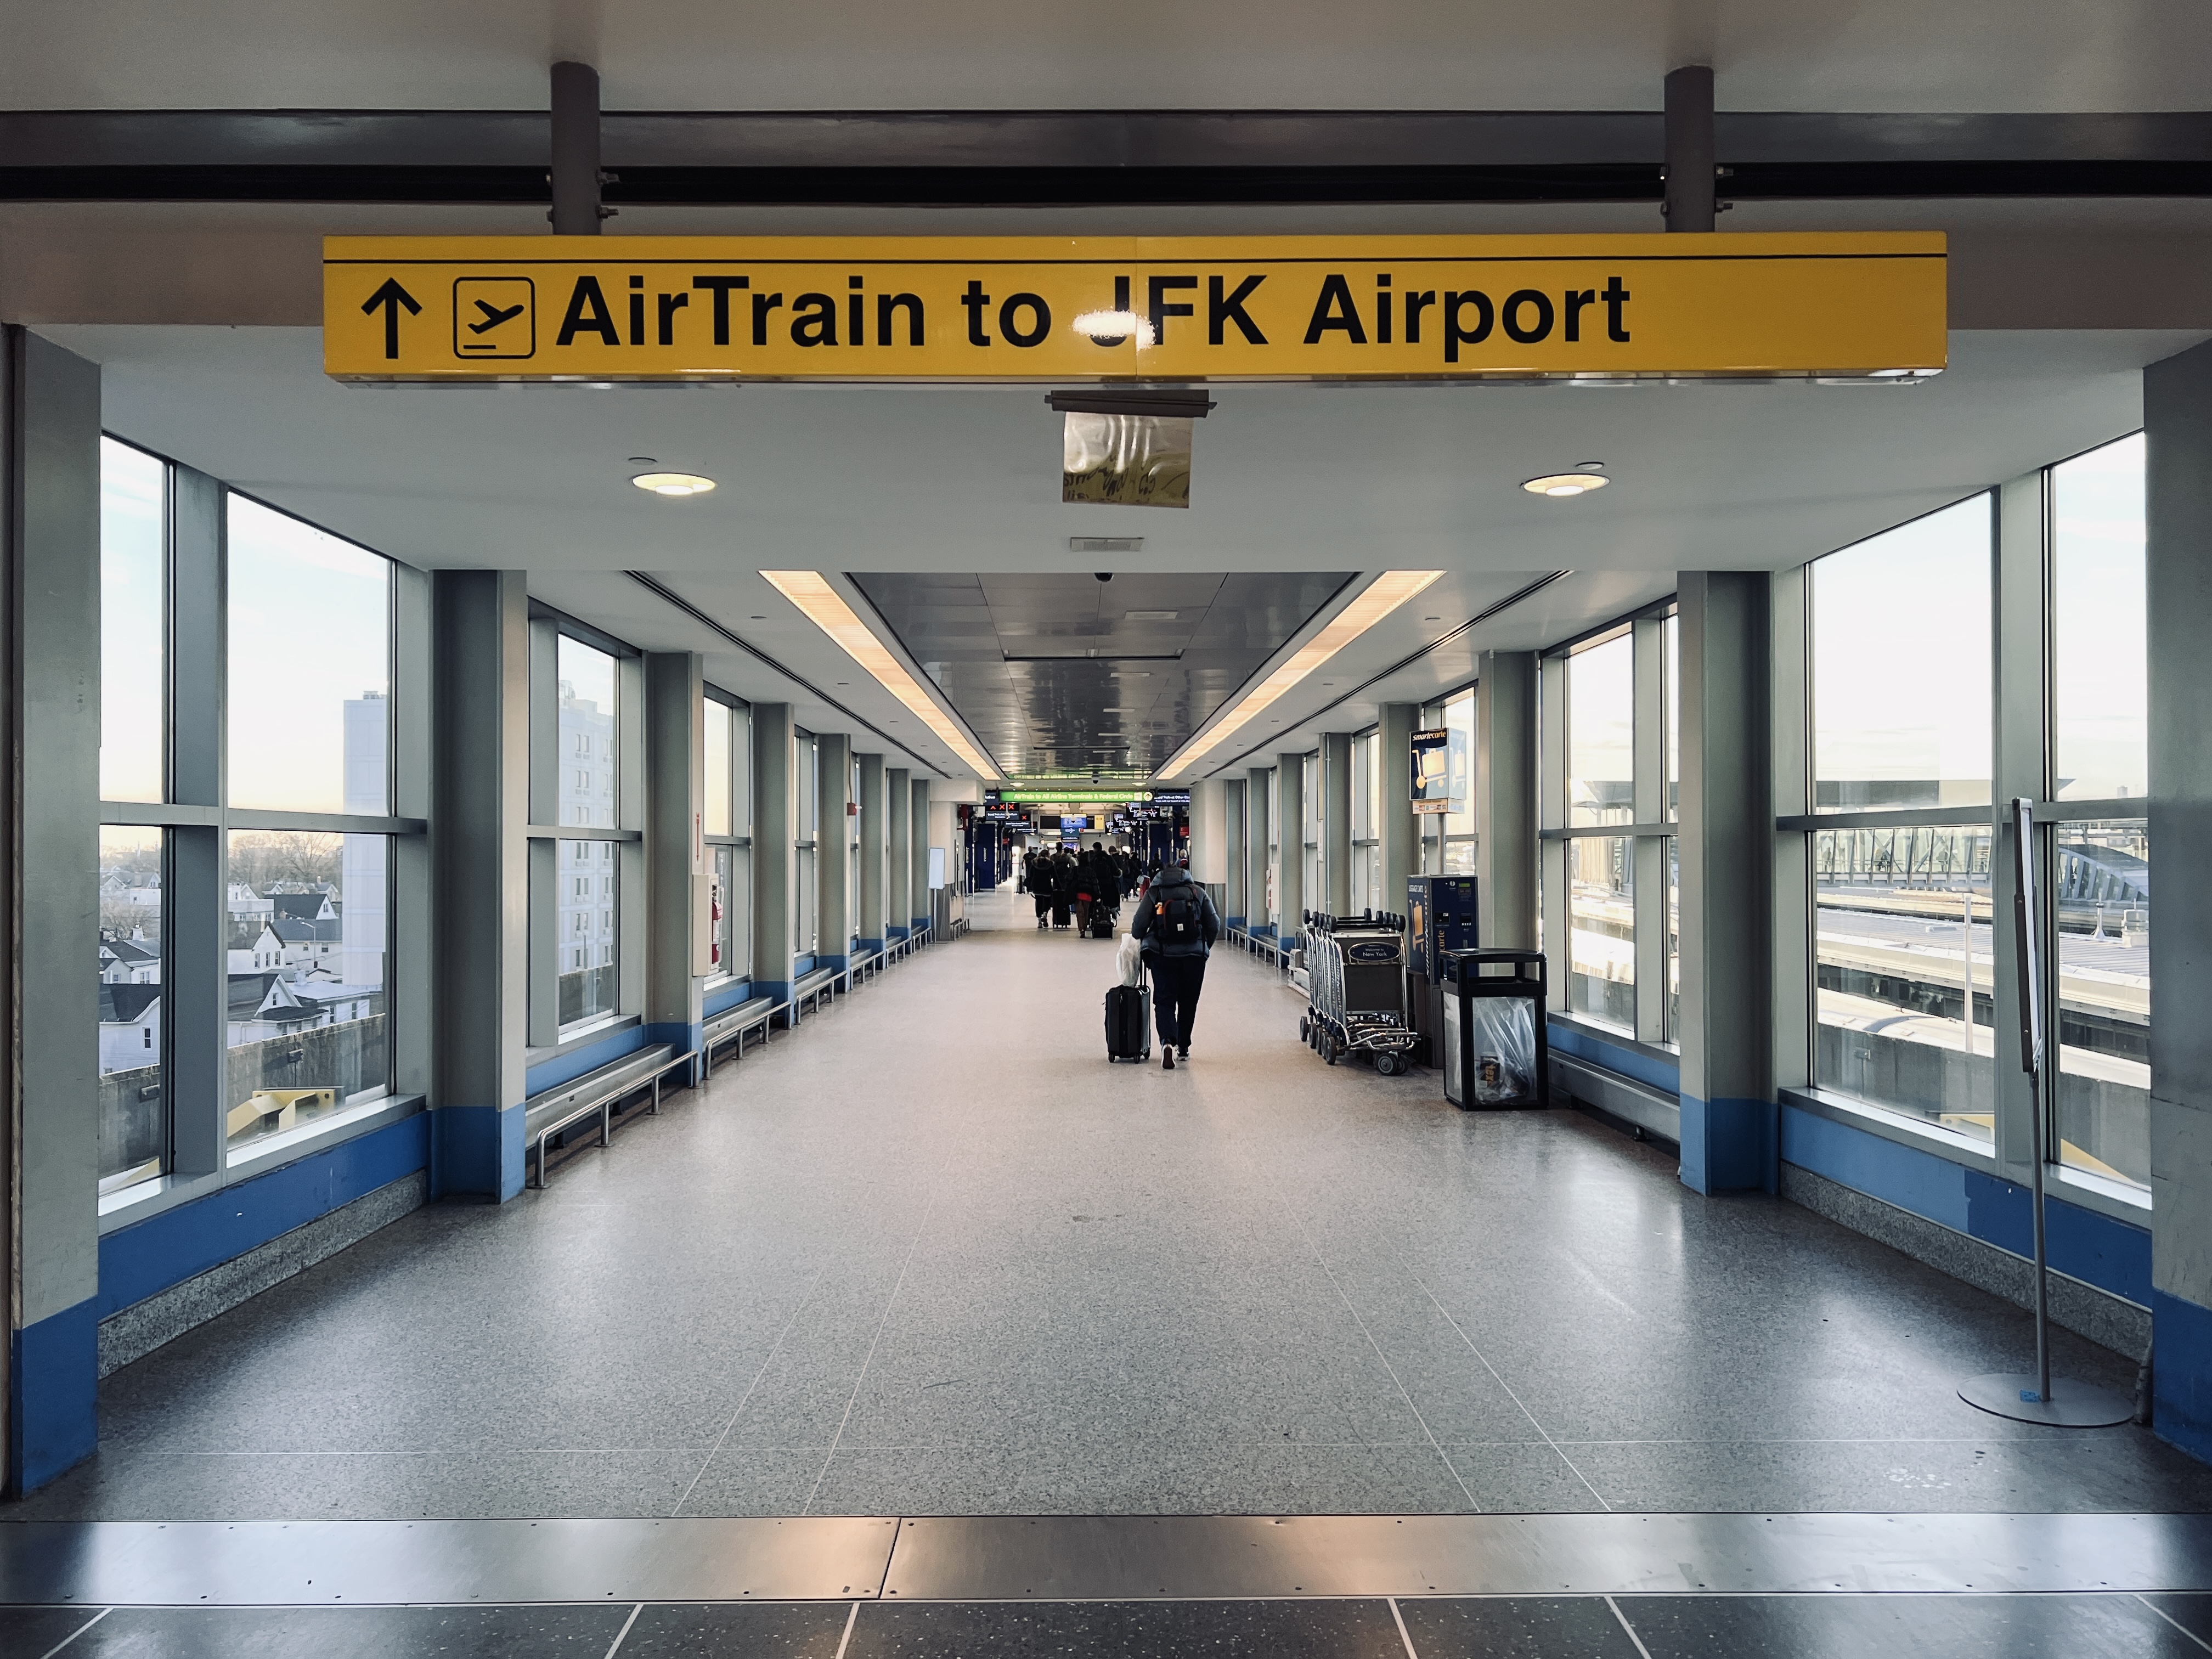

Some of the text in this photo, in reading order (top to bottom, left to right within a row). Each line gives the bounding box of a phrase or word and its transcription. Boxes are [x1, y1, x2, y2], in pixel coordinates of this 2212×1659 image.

[556, 273, 1630, 363] AirTrain to JFK Airport
